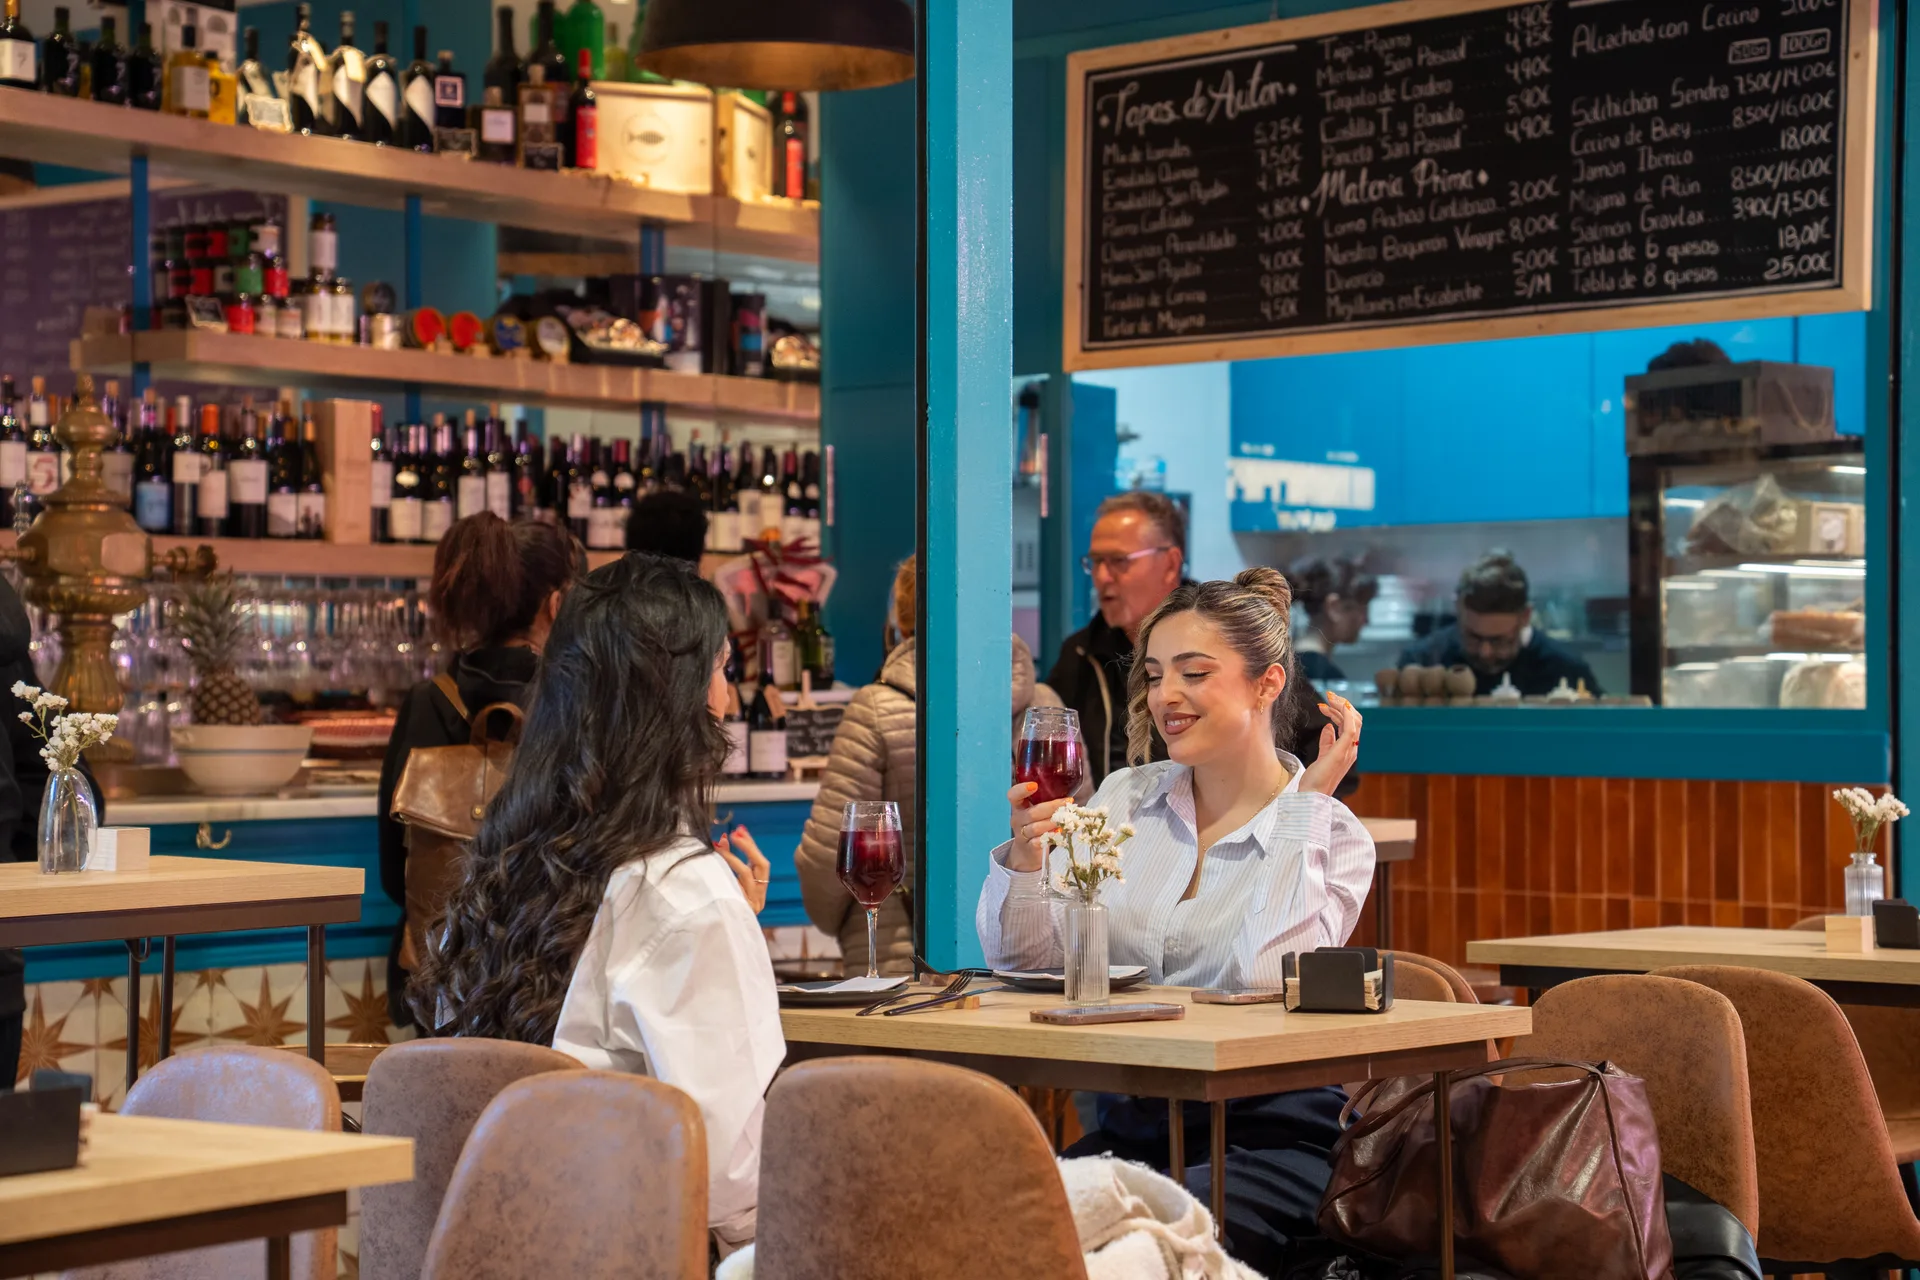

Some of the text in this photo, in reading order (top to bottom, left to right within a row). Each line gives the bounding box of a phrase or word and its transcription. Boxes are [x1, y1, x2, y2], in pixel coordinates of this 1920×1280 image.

[1656, 20, 1689, 42] con
[1097, 61, 1284, 136] Tapas de Autor
[1624, 121, 1643, 146] de
[1650, 115, 1692, 143] Buey
[1310, 157, 1475, 217] Materia Prima
[1633, 181, 1656, 204] de
[1567, 243, 1616, 268] Tabla
[1617, 238, 1637, 263] de
[1644, 233, 1661, 260] 6
[1665, 239, 1721, 266] quesos
[1569, 267, 1616, 294] Tabla
[1618, 267, 1640, 291] de
[1642, 261, 1659, 289] 8
[1662, 265, 1720, 292] quesos
